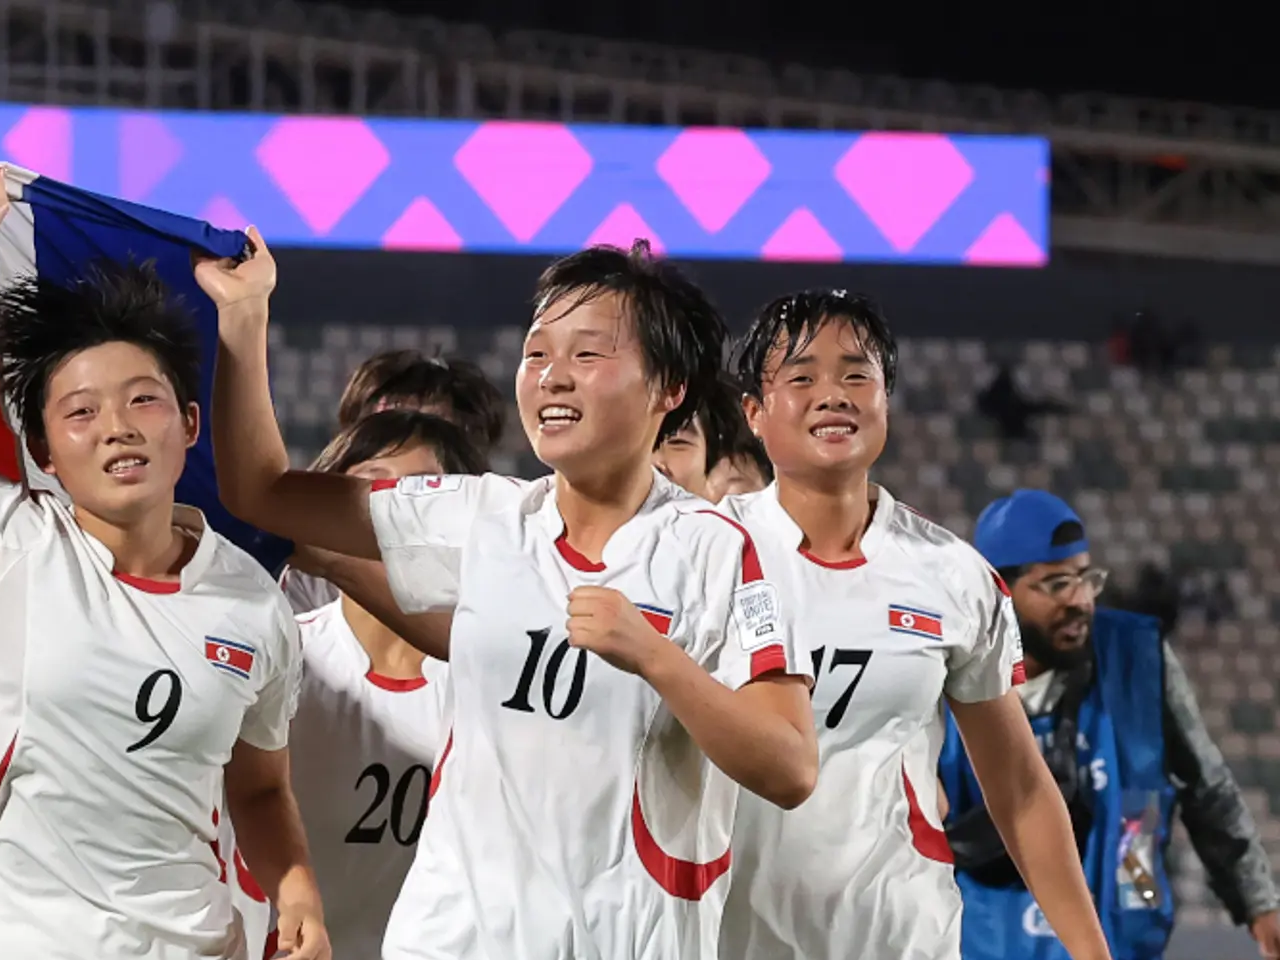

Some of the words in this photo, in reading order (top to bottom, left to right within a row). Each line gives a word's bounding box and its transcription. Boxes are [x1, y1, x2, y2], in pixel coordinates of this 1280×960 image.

[125, 669, 183, 754] 9
[501, 625, 587, 720] 10
[344, 762, 432, 847] 20
